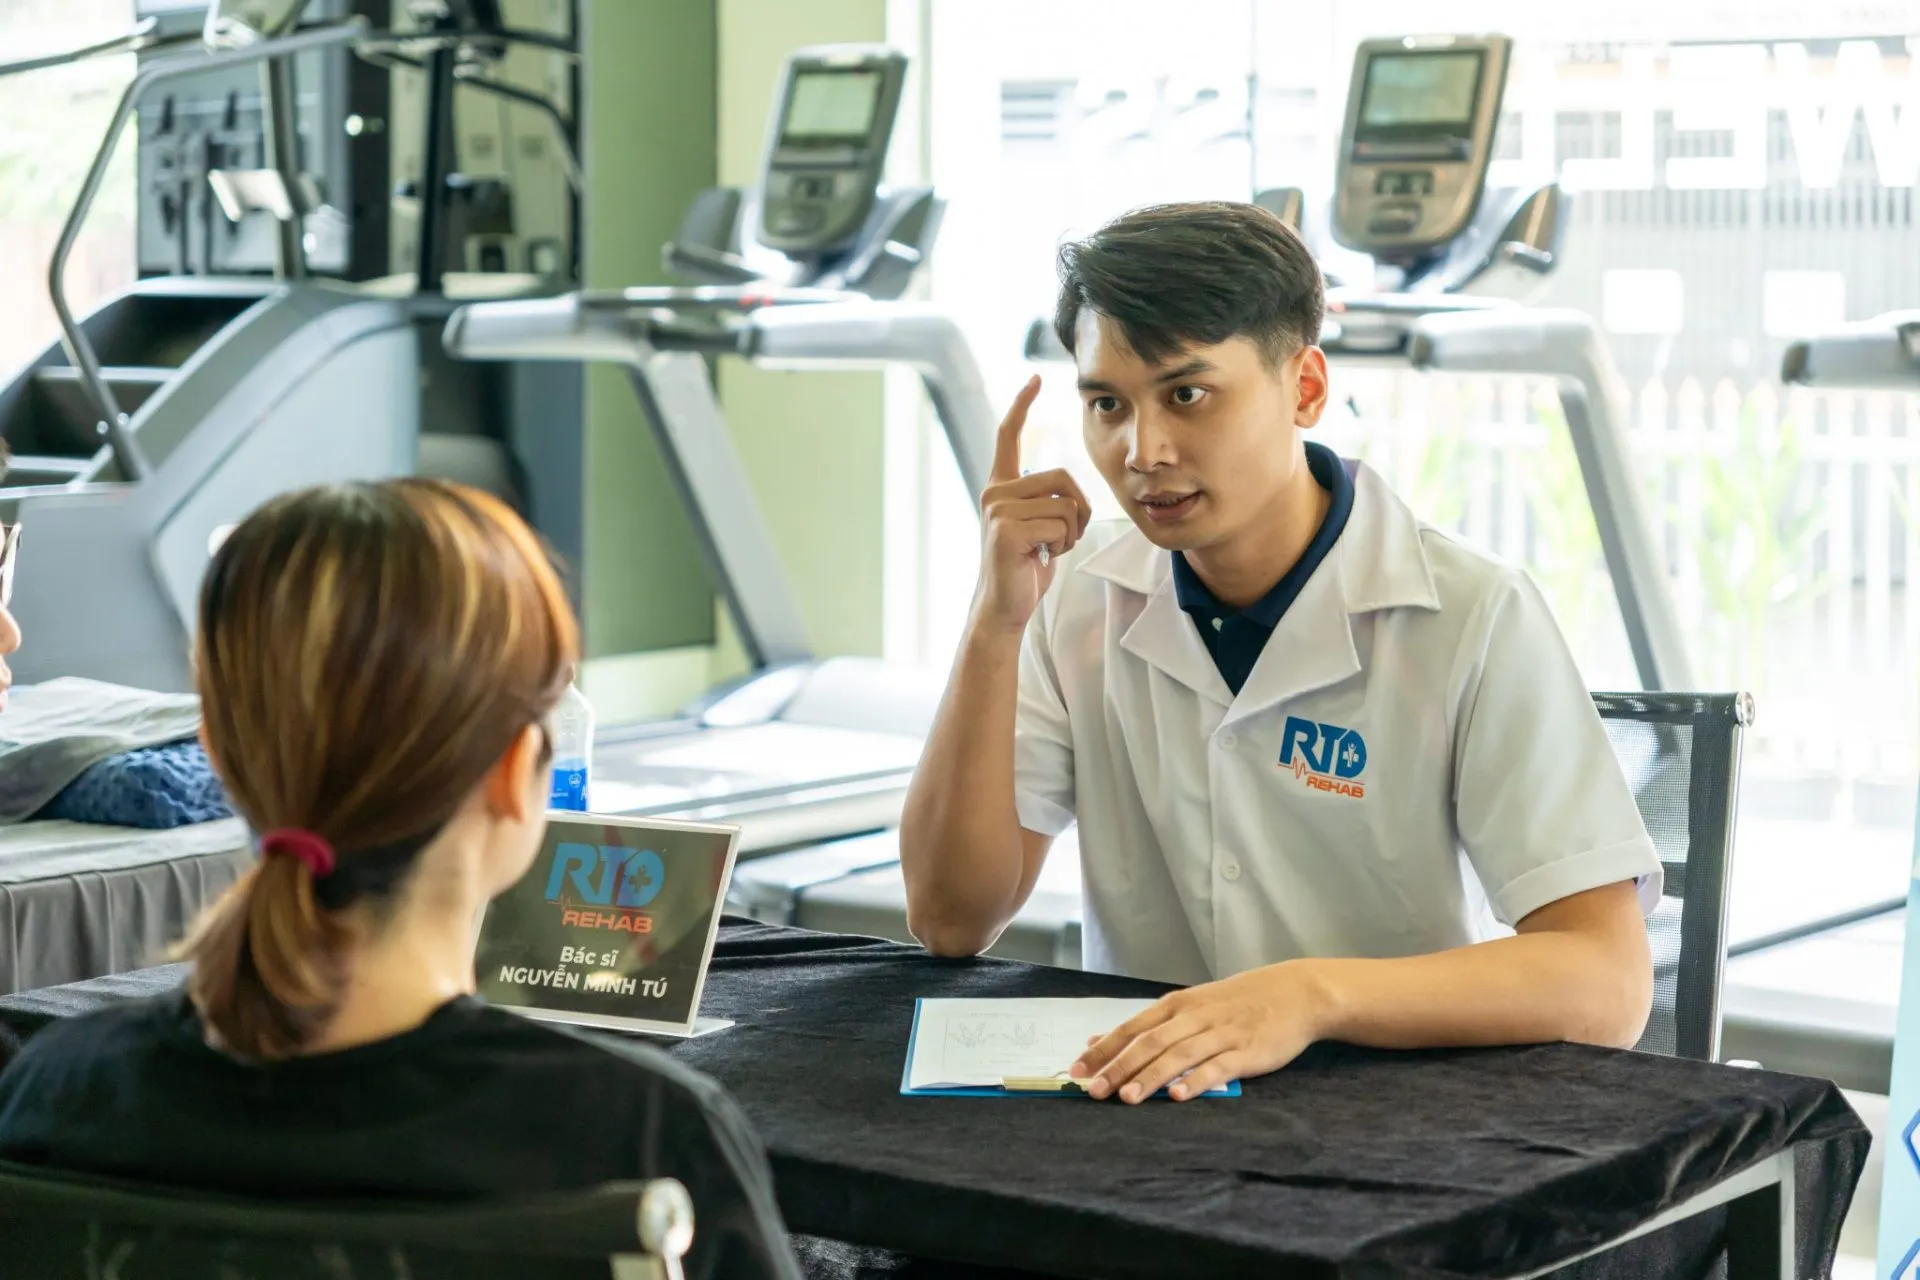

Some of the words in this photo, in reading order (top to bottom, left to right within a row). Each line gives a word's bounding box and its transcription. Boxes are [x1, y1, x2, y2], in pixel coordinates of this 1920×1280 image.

[1278, 716, 1366, 778] RTD
[1306, 776, 1364, 798] REHAB
[544, 842, 666, 908] RTD
[561, 910, 653, 934] REHAB
[559, 946, 597, 966] Bác
[600, 949, 619, 968] sĩ
[499, 964, 580, 990] NGUYỄN
[583, 974, 637, 996] MINH
[642, 977, 668, 999] TÚ
